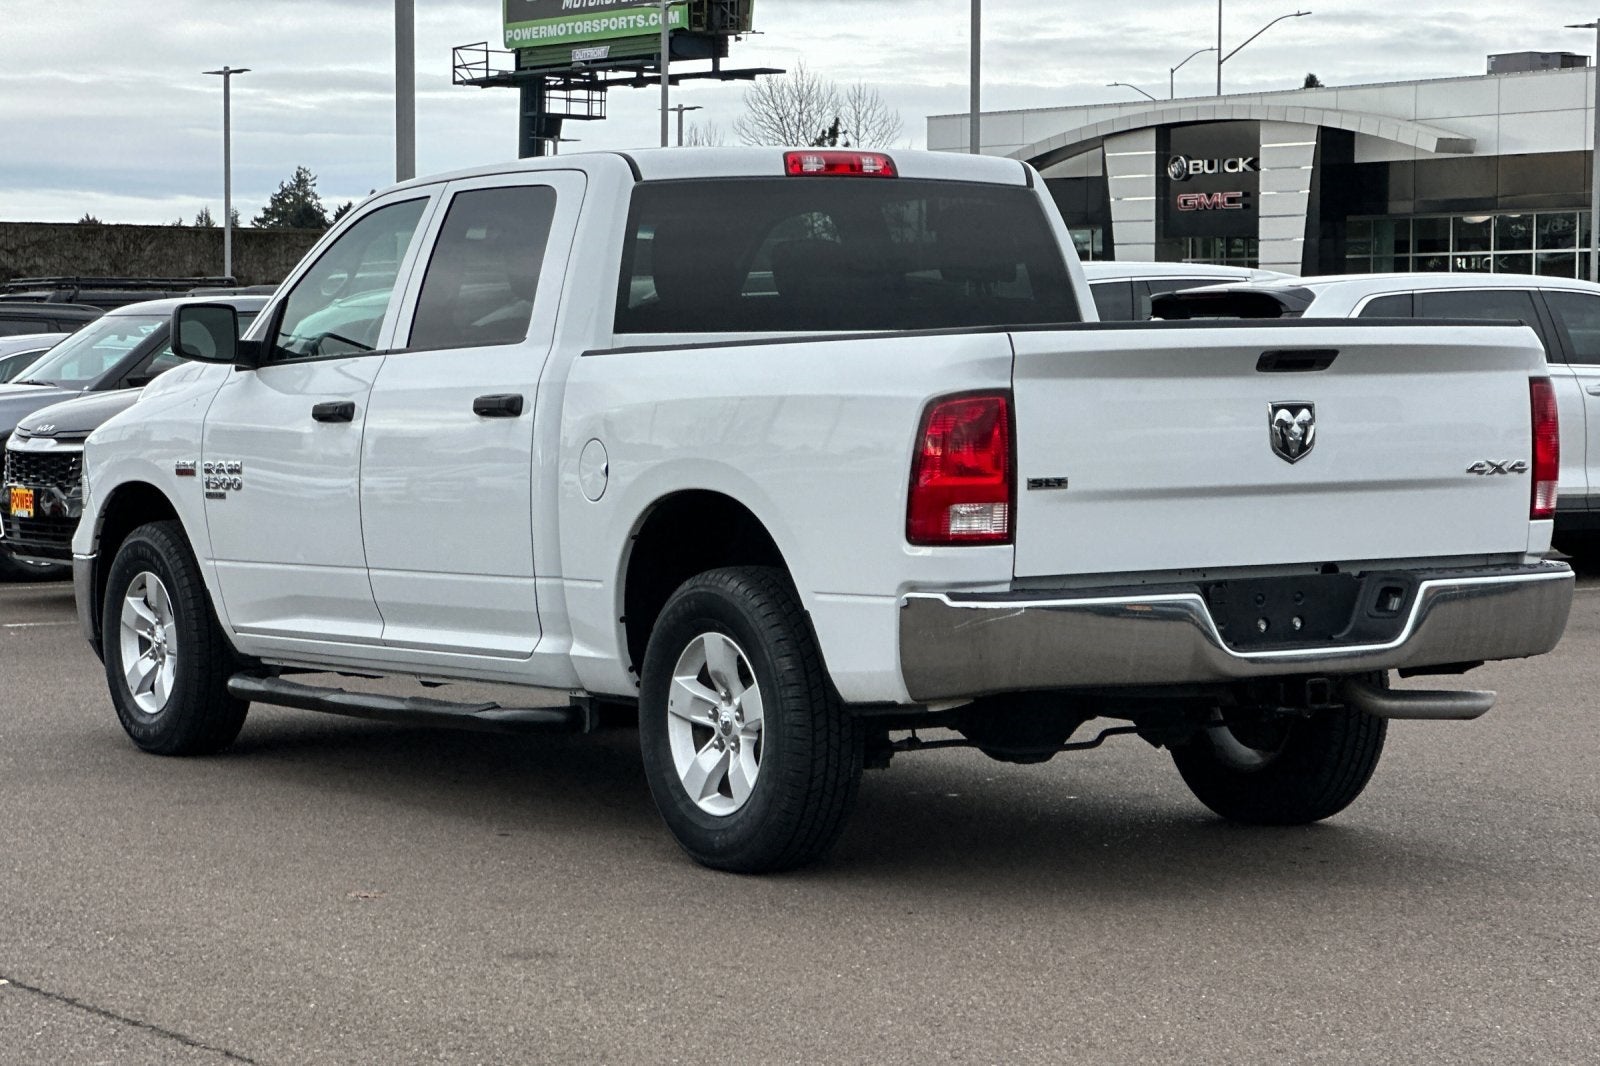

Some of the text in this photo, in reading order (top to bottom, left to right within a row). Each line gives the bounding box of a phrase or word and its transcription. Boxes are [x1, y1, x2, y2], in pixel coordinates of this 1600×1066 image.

[575, 48, 605, 59] OUTFRONT
[1189, 157, 1254, 175] BUICK
[1177, 191, 1243, 211] GMC
[204, 476, 243, 491] 1500
[11, 492, 33, 509] POWER
